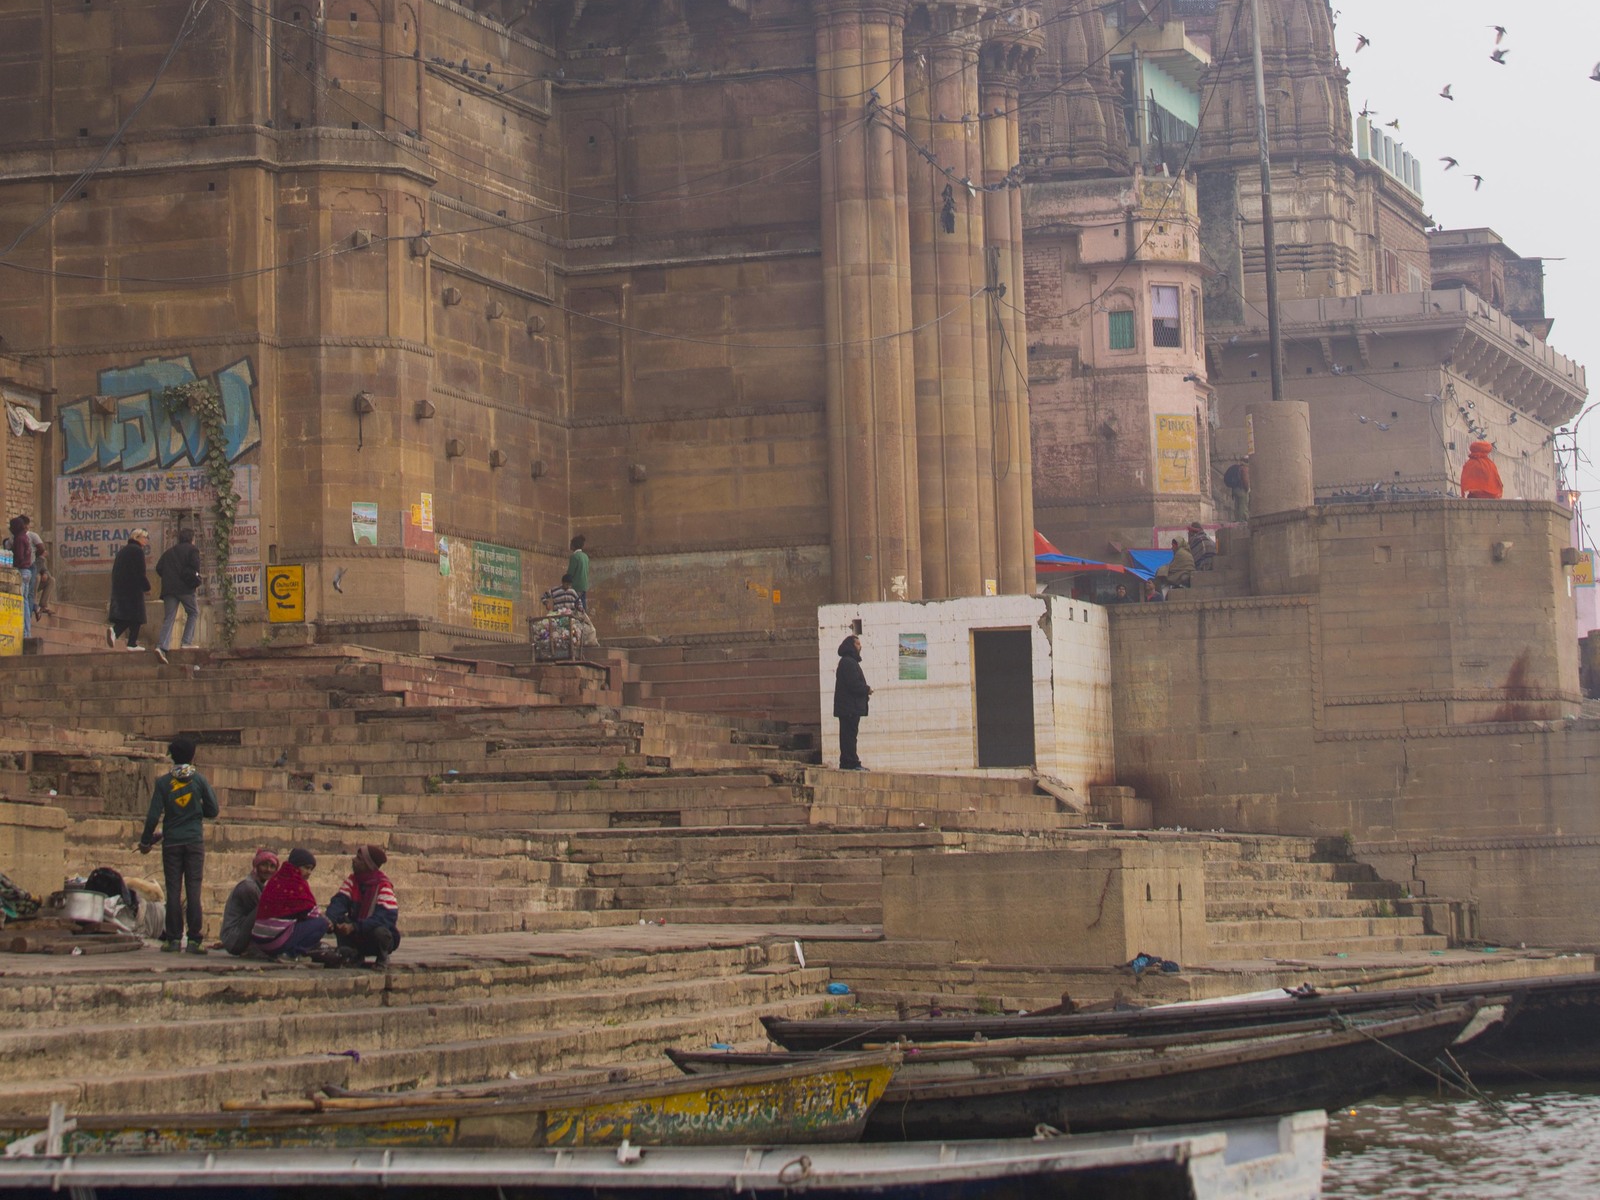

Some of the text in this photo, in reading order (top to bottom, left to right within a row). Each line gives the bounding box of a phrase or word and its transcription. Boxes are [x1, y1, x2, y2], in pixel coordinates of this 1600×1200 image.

[136, 477, 160, 492] ON
[143, 492, 167, 503] HOUSE
[70, 508, 126, 520] SUNRISE
